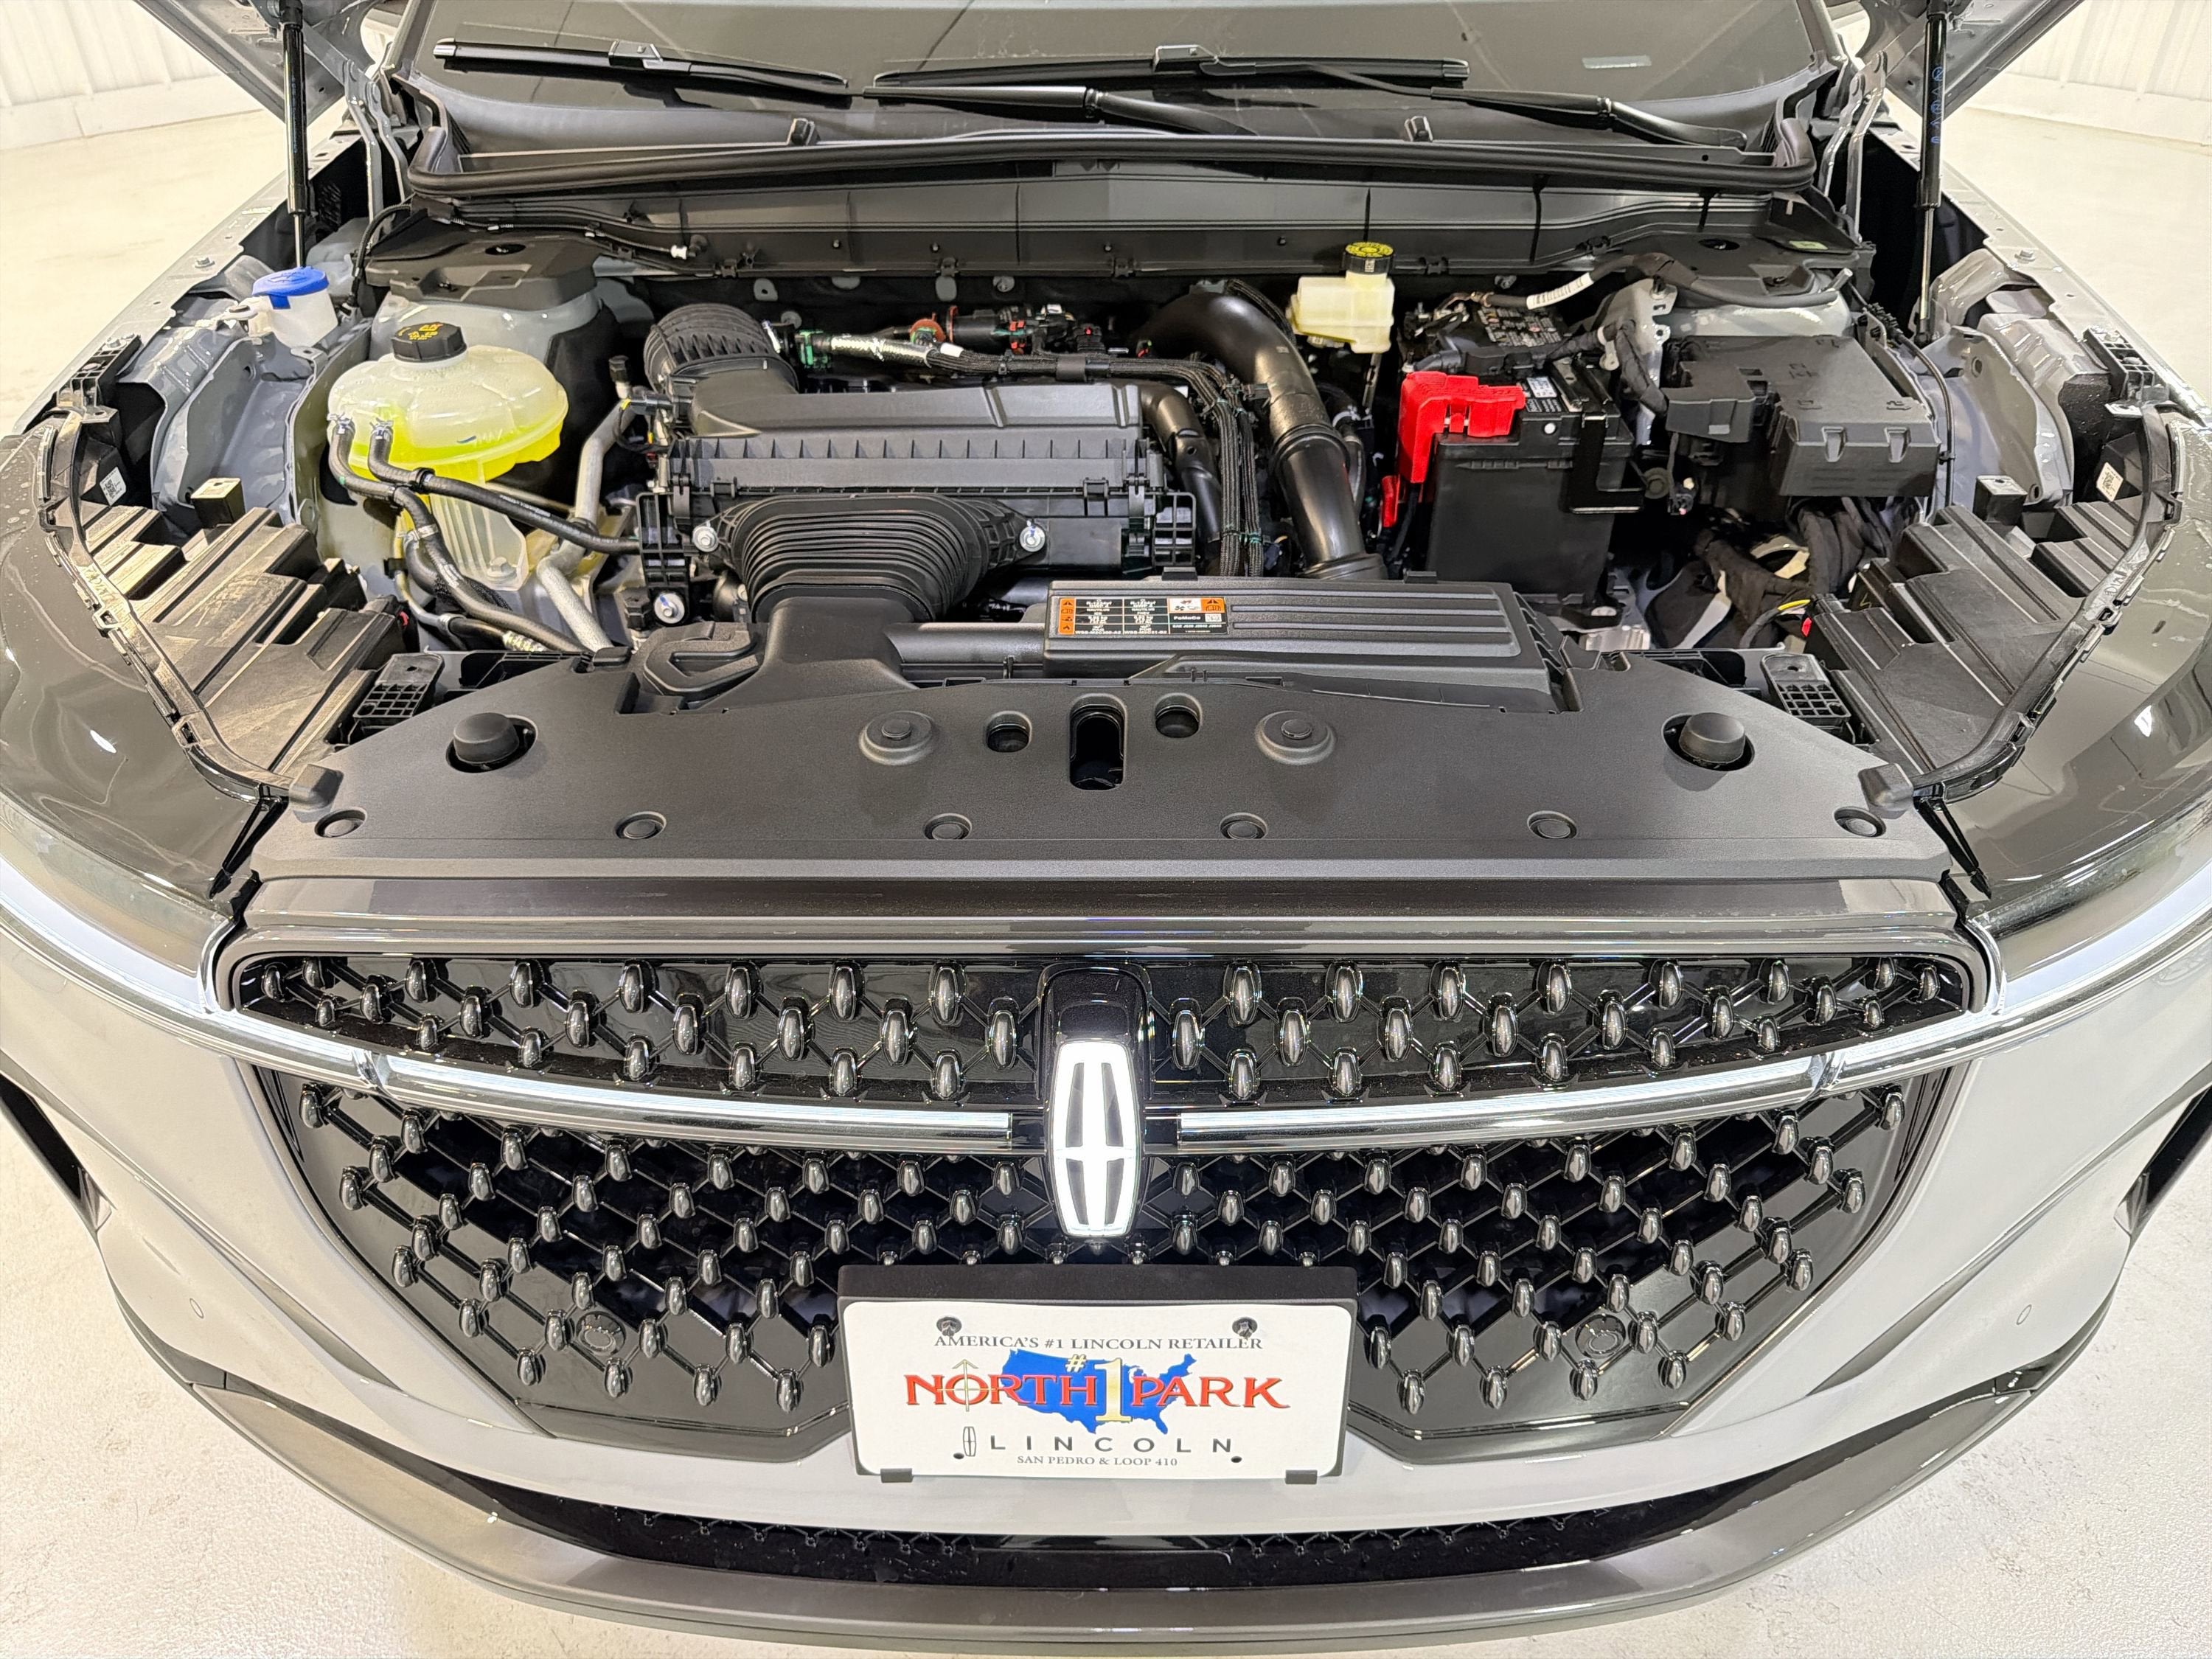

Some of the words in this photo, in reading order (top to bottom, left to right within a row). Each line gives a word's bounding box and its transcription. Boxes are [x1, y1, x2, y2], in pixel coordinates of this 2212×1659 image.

[934, 1335, 1039, 1348] AMERICA'S
[1044, 1338, 1064, 1349] #1
[1071, 1338, 1164, 1349] LINCOLN
[1168, 1338, 1263, 1349] RETAILER
[904, 1374, 1098, 1405] NORTH
[1130, 1376, 1291, 1409] PARK
[990, 1434, 1231, 1453] LINCOLN
[1017, 1455, 1044, 1465] SAN
[1048, 1456, 1096, 1466] PEDRO
[1099, 1458, 1110, 1466] &
[1113, 1457, 1152, 1467] LOOP
[1155, 1457, 1178, 1467] 410
